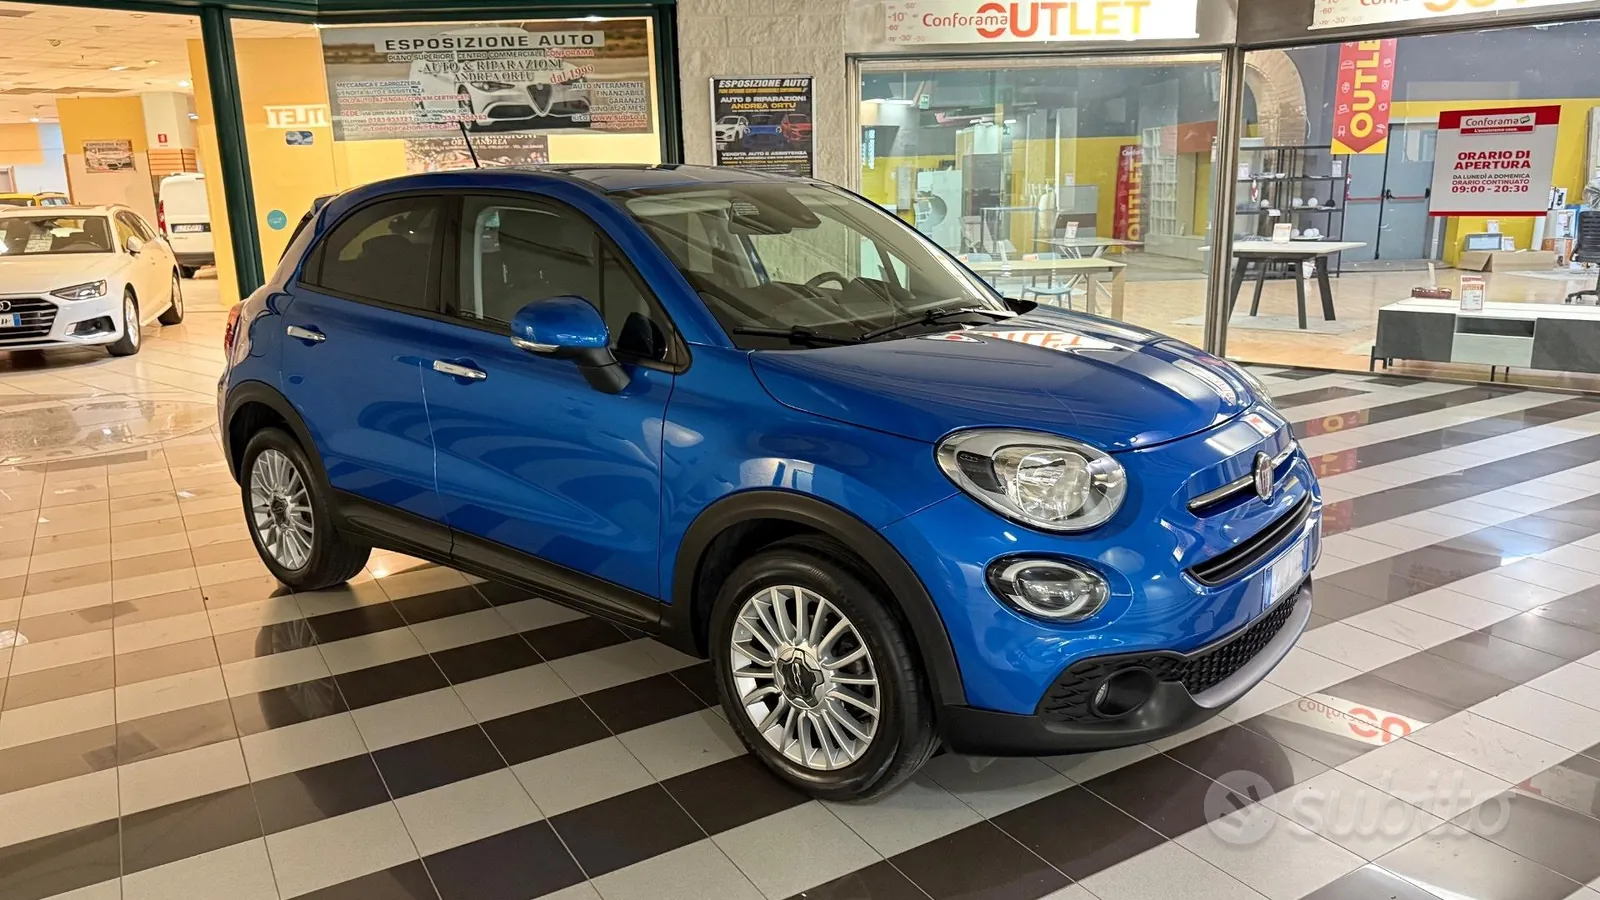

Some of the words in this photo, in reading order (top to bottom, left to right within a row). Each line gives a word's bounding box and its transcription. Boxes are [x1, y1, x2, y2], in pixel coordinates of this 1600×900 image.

[922, 12, 1008, 28] Conforama
[976, 1, 1150, 38] OUTLET
[385, 36, 528, 50] ESPOSIZIONE
[539, 34, 594, 46] AUTO
[413, 53, 455, 61] SUPERIORE
[489, 50, 543, 58] COMMERCIALE
[546, 49, 594, 57] CONFORAMA
[423, 62, 459, 74] AUTO
[462, 63, 473, 71] &
[477, 59, 564, 71] RIPARAZIONI
[454, 72, 500, 82] ANDREA
[502, 71, 534, 81] ORTU
[550, 71, 567, 83] dal
[570, 65, 594, 80] 1999
[718, 80, 780, 88] ESPOSIZIONE
[782, 79, 809, 87] AUTO
[596, 89, 645, 97] FINANZIABILE
[753, 95, 806, 103] RIPARAZIONI
[731, 102, 769, 110] ANDREA
[1465, 118, 1519, 127] Conforama
[1457, 150, 1512, 160] ORARIO
[1515, 150, 1530, 159] DI
[1453, 160, 1531, 170] APERTURA
[1494, 185, 1529, 193] 20:30
[1128, 158, 1141, 240] OUTLET
